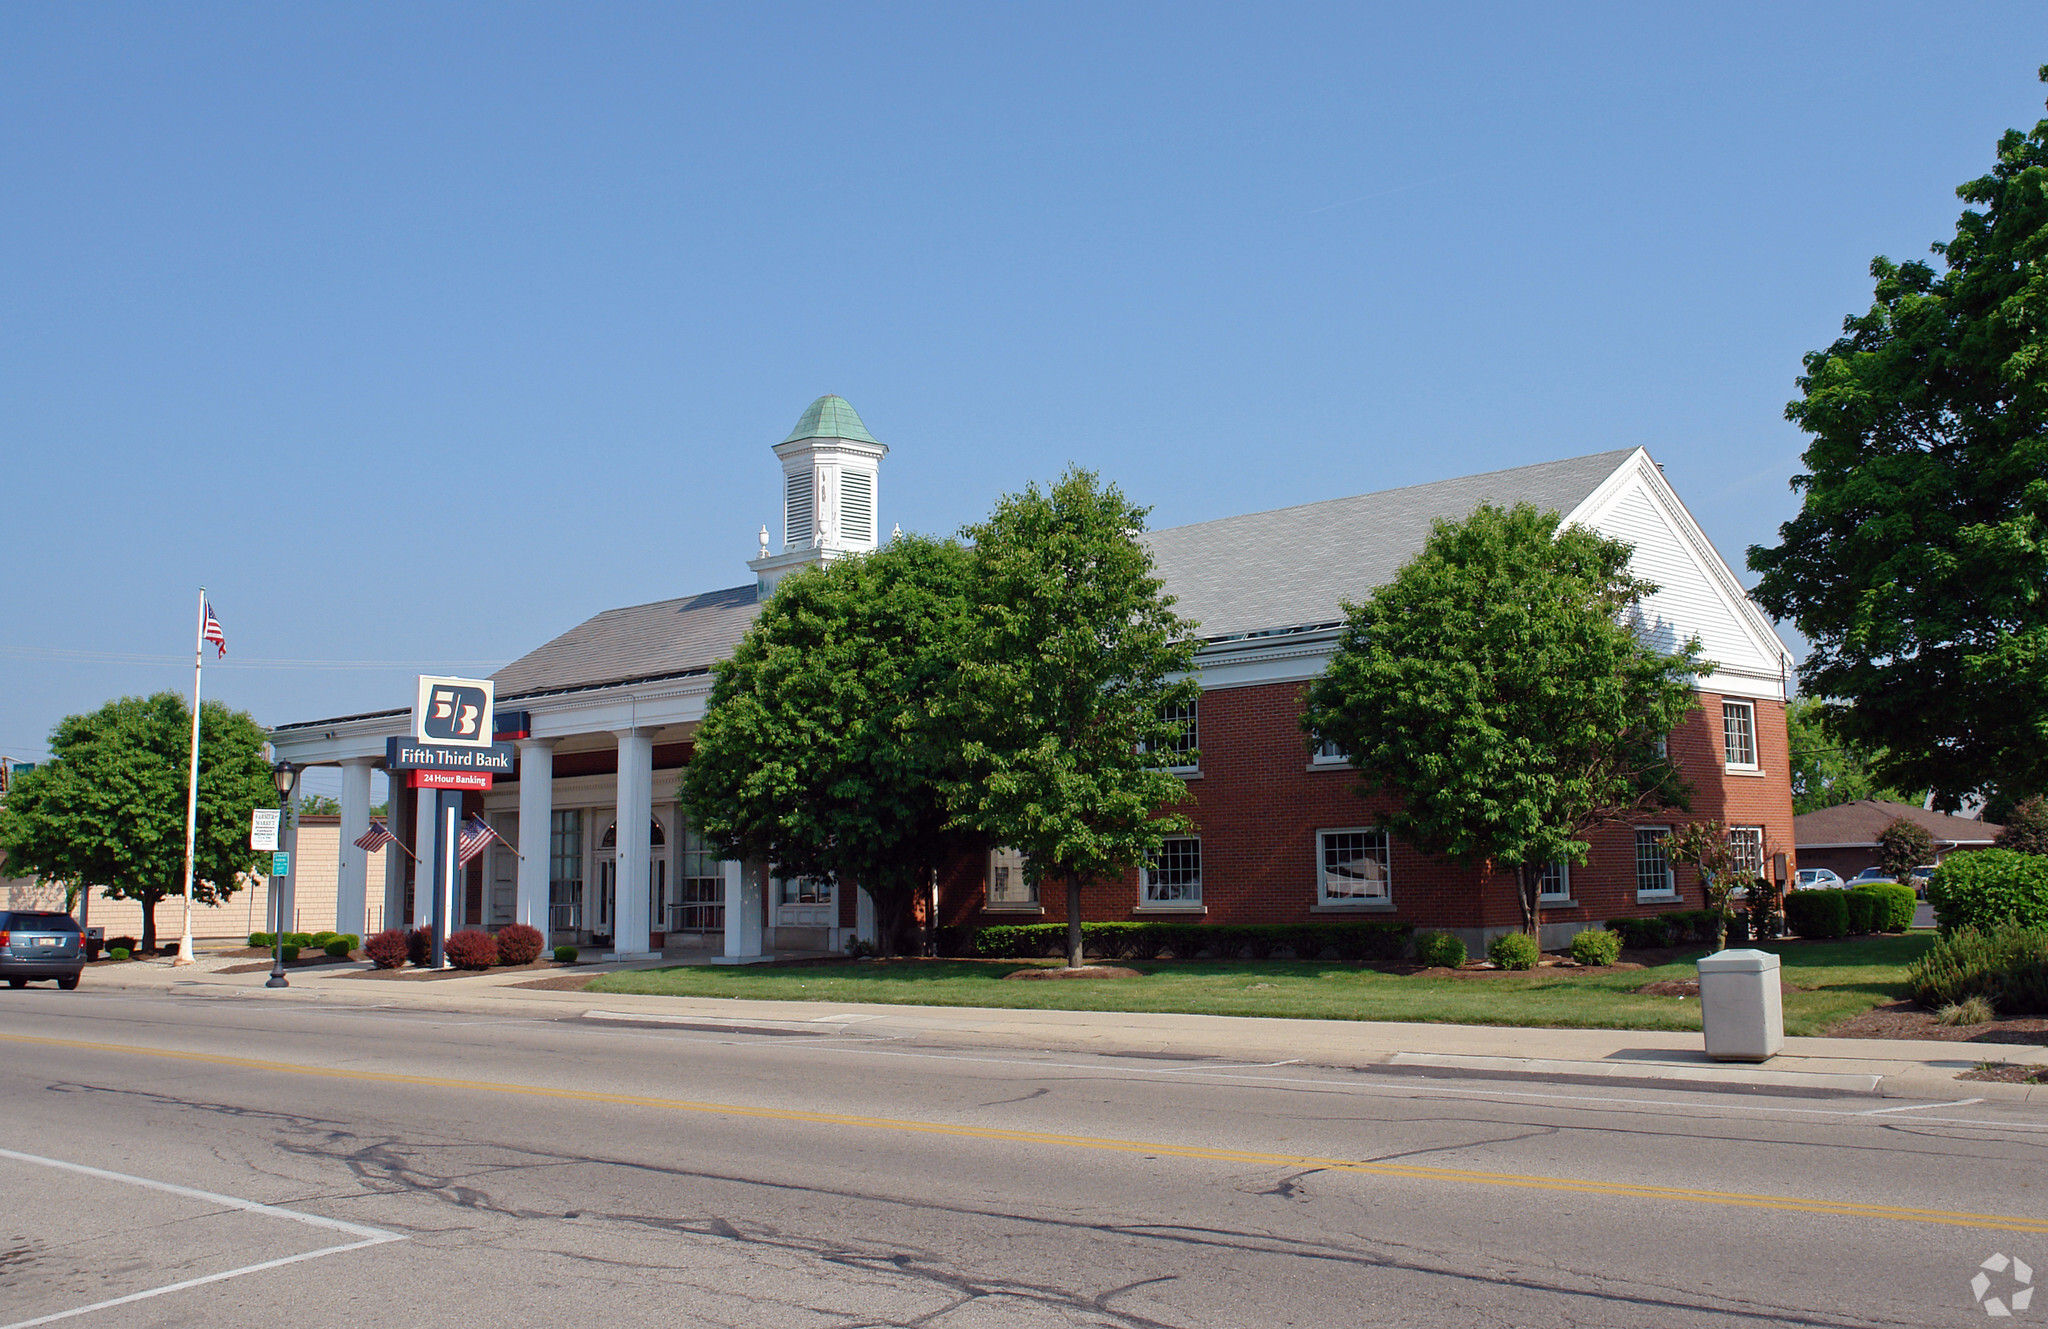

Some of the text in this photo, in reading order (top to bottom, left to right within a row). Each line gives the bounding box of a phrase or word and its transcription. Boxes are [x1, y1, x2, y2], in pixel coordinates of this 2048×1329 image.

[401, 748, 509, 767] Fifth Third Bank
[424, 774, 486, 787] 24 Hour Banking
